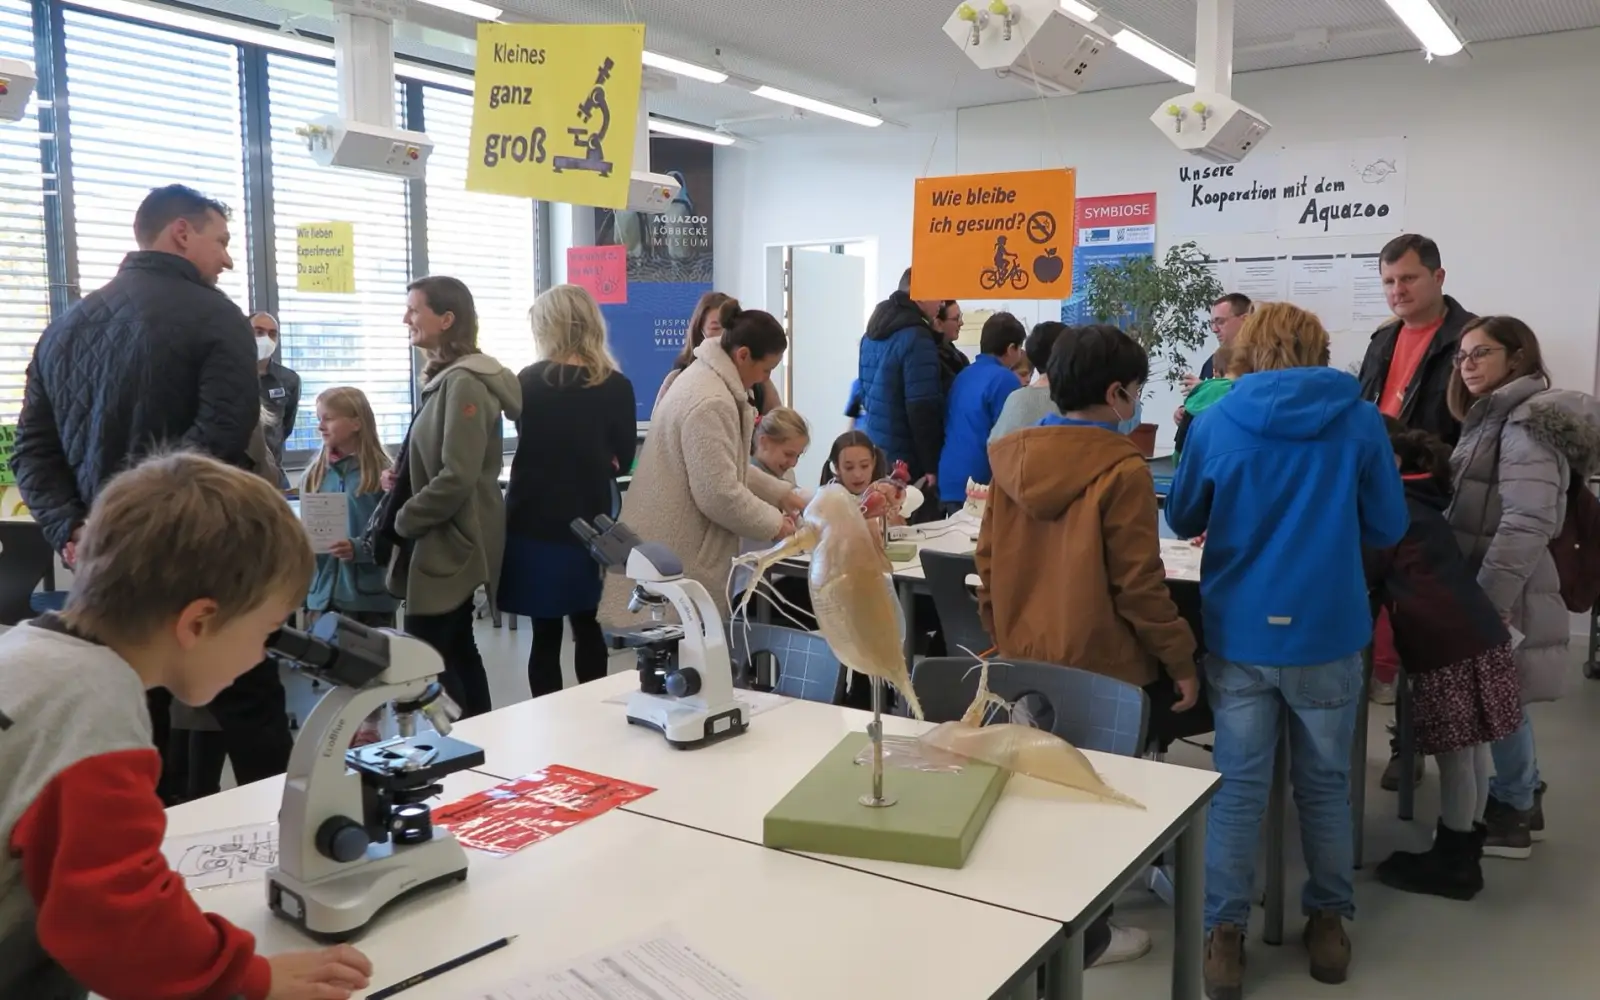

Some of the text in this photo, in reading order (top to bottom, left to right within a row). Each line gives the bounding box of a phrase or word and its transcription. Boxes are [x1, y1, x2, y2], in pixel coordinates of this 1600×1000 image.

[494, 42, 546, 64] Kleines
[489, 85, 533, 109] ganz
[484, 126, 547, 168] groß
[1179, 164, 1235, 182] Unsere
[932, 187, 1017, 206] Wie bleibe
[1191, 175, 1346, 212] Kooperation mit dem
[653, 215, 708, 224] AQUAZOO
[1084, 203, 1150, 219] SYMBIOSE
[1298, 198, 1390, 232] Aquazoo
[653, 225, 708, 236] LÖBBECKE
[929, 212, 1026, 236] ich gesund?
[297, 227, 334, 239] Wir lieben
[297, 244, 344, 258] Experimente!
[653, 238, 708, 247] MUSEUM
[297, 262, 330, 275] Du auch?
[654, 328, 686, 336] EVOLU
